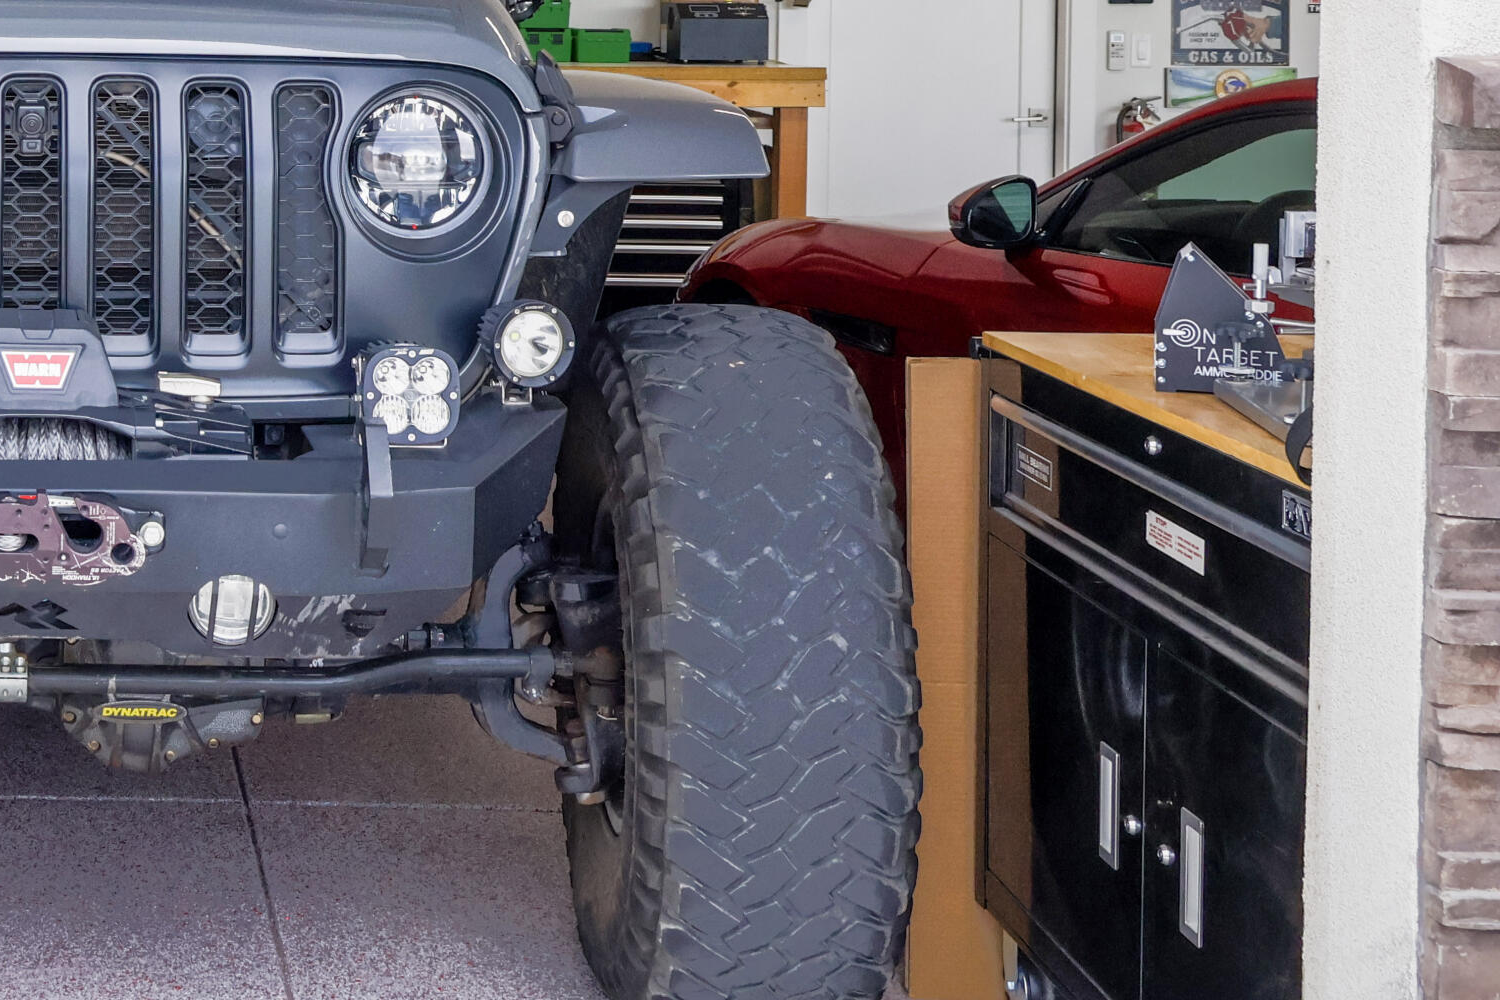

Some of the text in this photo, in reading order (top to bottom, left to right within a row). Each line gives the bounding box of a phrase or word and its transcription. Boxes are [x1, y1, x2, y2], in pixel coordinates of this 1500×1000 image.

[1189, 51, 1274, 63] GAS & OILS
[1193, 347, 1279, 367] TARGET
[13, 362, 62, 378] WARN
[102, 707, 178, 718] DYNATRAC
